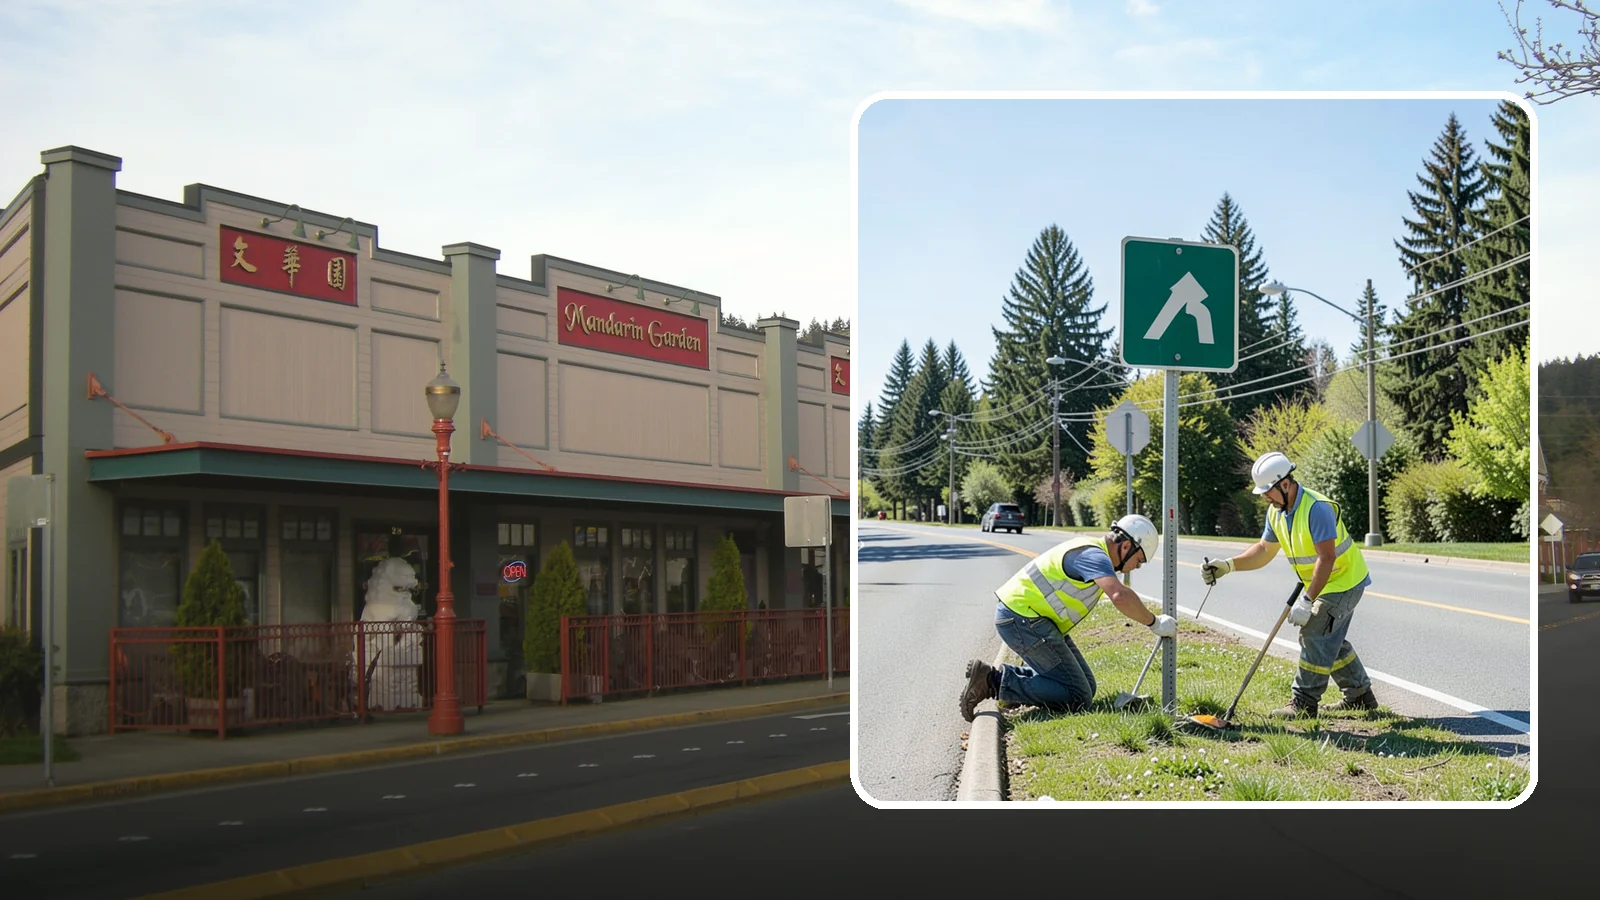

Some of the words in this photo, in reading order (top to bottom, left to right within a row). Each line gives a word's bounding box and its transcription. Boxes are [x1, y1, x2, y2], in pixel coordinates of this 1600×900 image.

[230, 236, 346, 291] 文華園
[564, 302, 644, 341] Mandarin
[648, 320, 701, 352] Garden
[835, 363, 846, 386] 文
[503, 565, 527, 578] OPEN
